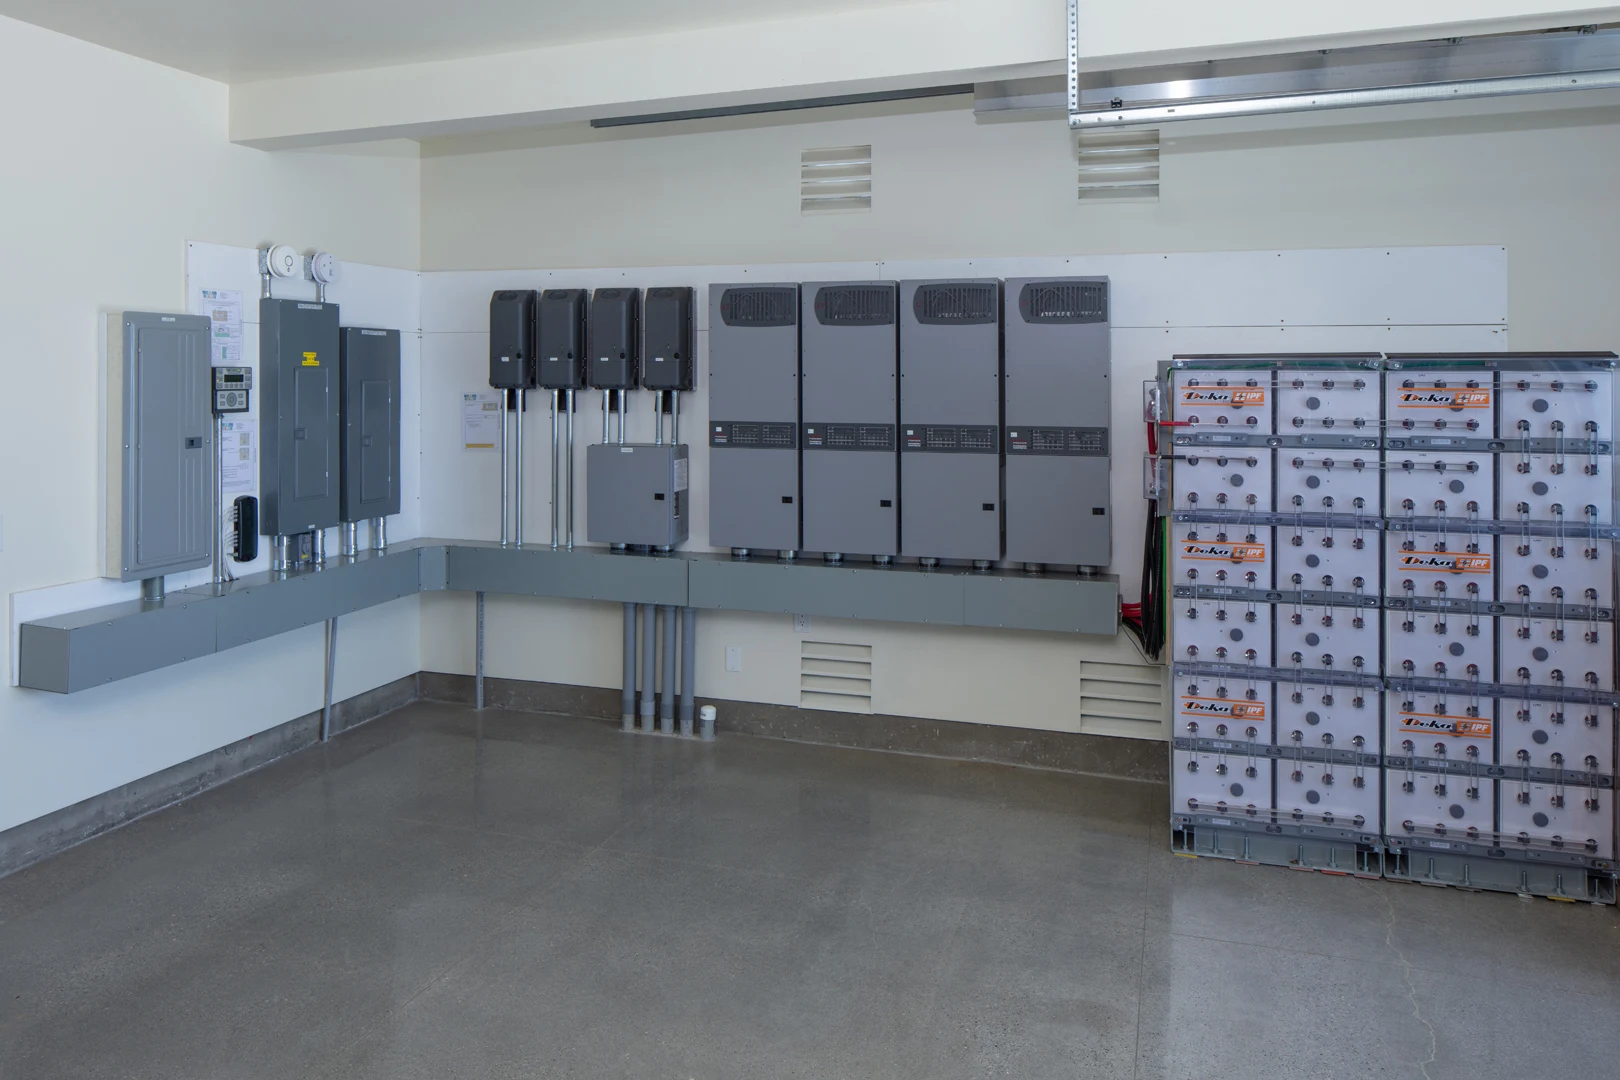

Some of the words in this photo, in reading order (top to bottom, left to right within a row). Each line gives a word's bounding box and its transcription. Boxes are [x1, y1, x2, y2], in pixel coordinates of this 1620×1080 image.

[1183, 391, 1230, 401] Deka
[1246, 392, 1263, 400] IPF
[1400, 393, 1451, 403] Deka
[1469, 394, 1488, 402] IPF
[1183, 545, 1230, 555] Deka
[1246, 548, 1263, 556] IPF
[1401, 556, 1452, 567] Deka
[1470, 559, 1488, 567] IPF
[1183, 701, 1230, 712] Deka
[1246, 706, 1263, 714] IPF
[1401, 718, 1452, 730] Deka
[1471, 723, 1489, 732] IPF
